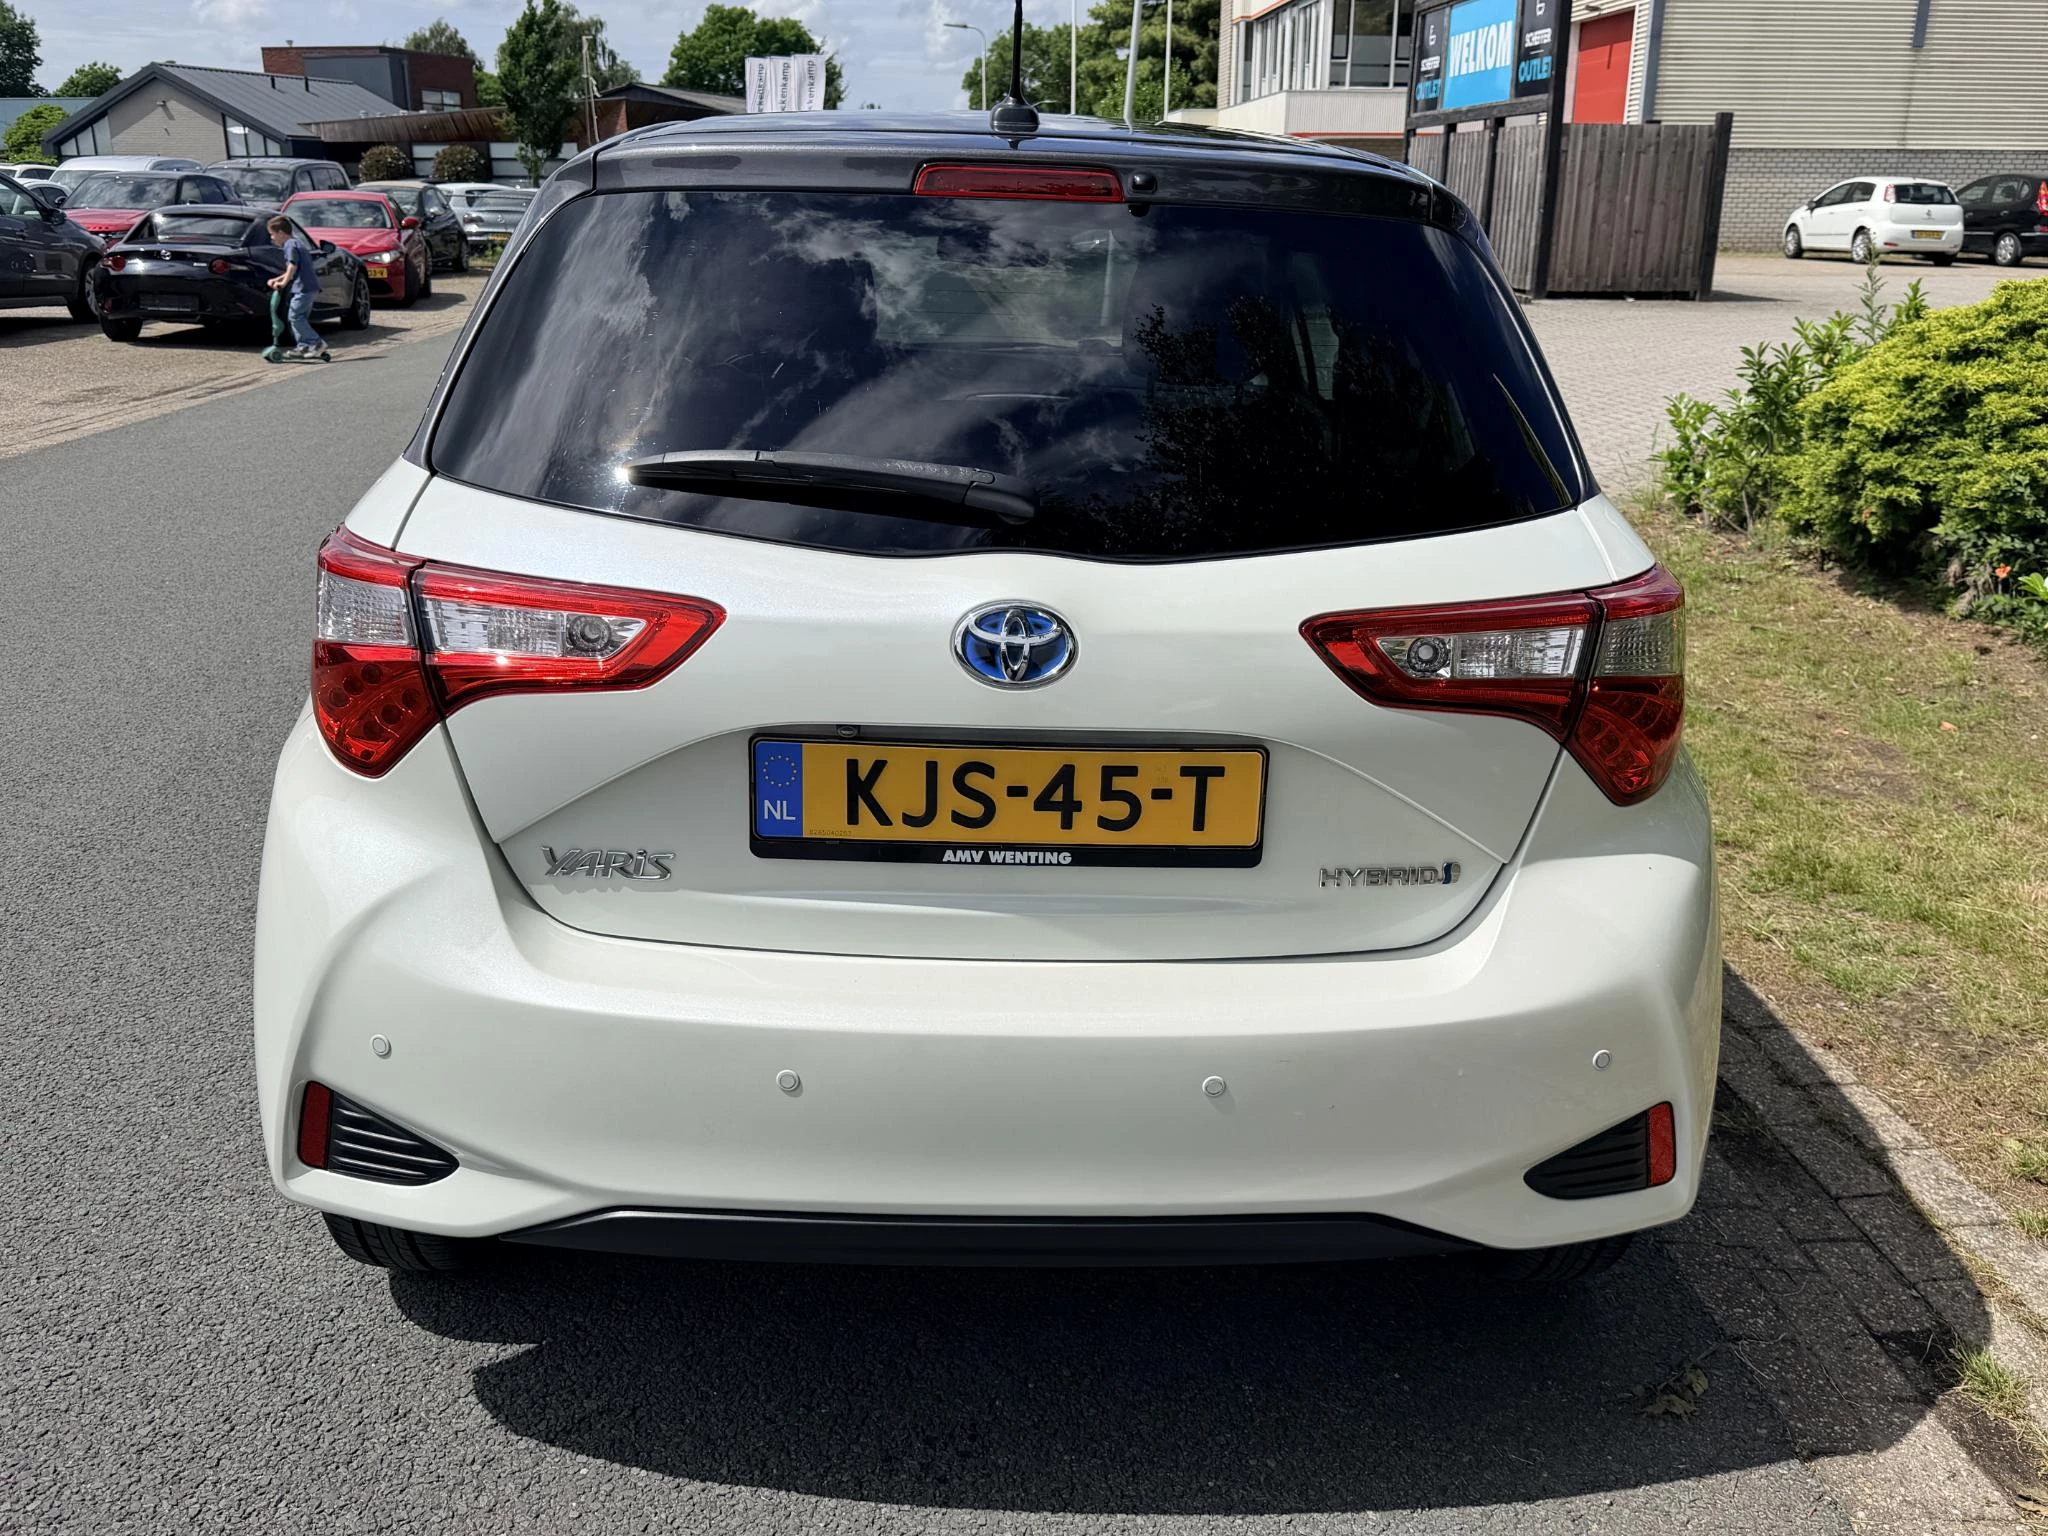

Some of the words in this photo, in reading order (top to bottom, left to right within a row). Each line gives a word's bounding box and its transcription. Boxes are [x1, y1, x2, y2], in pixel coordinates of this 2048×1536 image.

[1449, 20, 1513, 78] WELKOM
[1519, 56, 1552, 83] OUTLET
[846, 758, 1225, 832] KJS-45-T
[764, 799, 796, 820] NL
[942, 850, 984, 863] AMV
[988, 851, 1073, 865] WENTING
[1319, 867, 1440, 888] HYBRID
